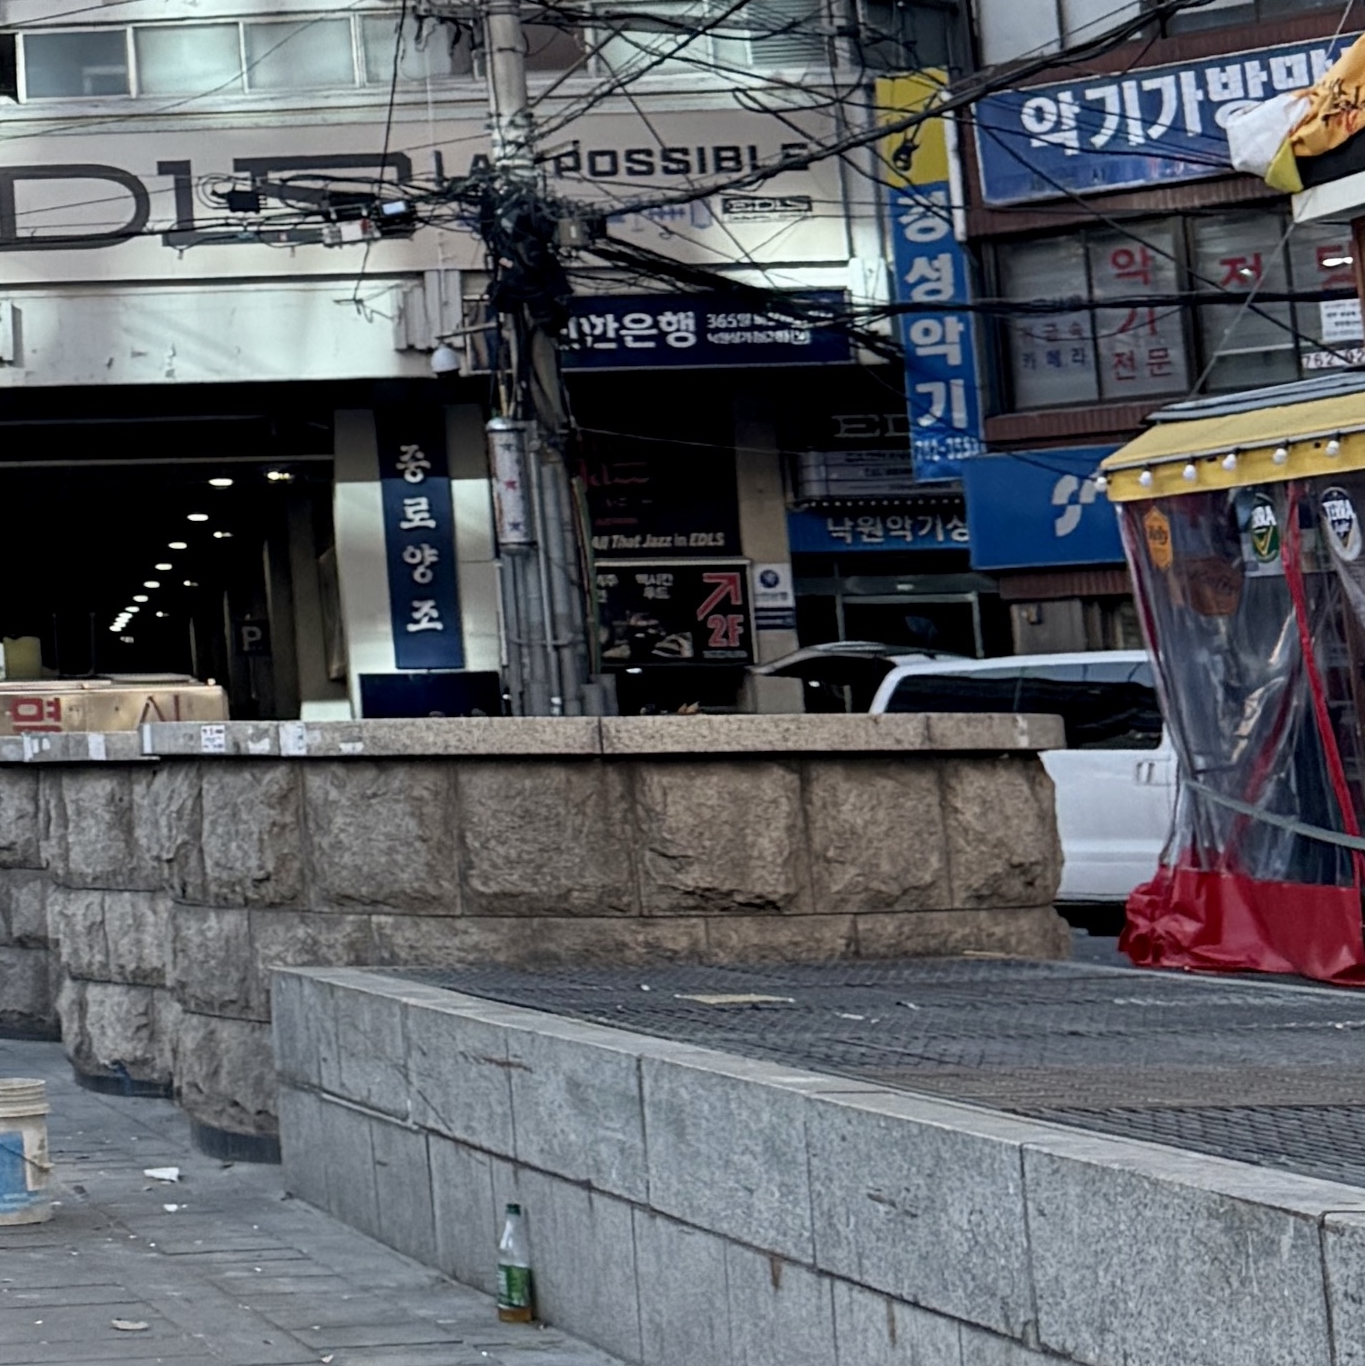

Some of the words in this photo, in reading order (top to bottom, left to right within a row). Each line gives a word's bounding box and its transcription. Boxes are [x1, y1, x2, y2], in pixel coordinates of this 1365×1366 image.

[1114, 348, 1172, 381] 전문
[396, 444, 444, 632] 종로양조
[707, 615, 744, 647] 2F
